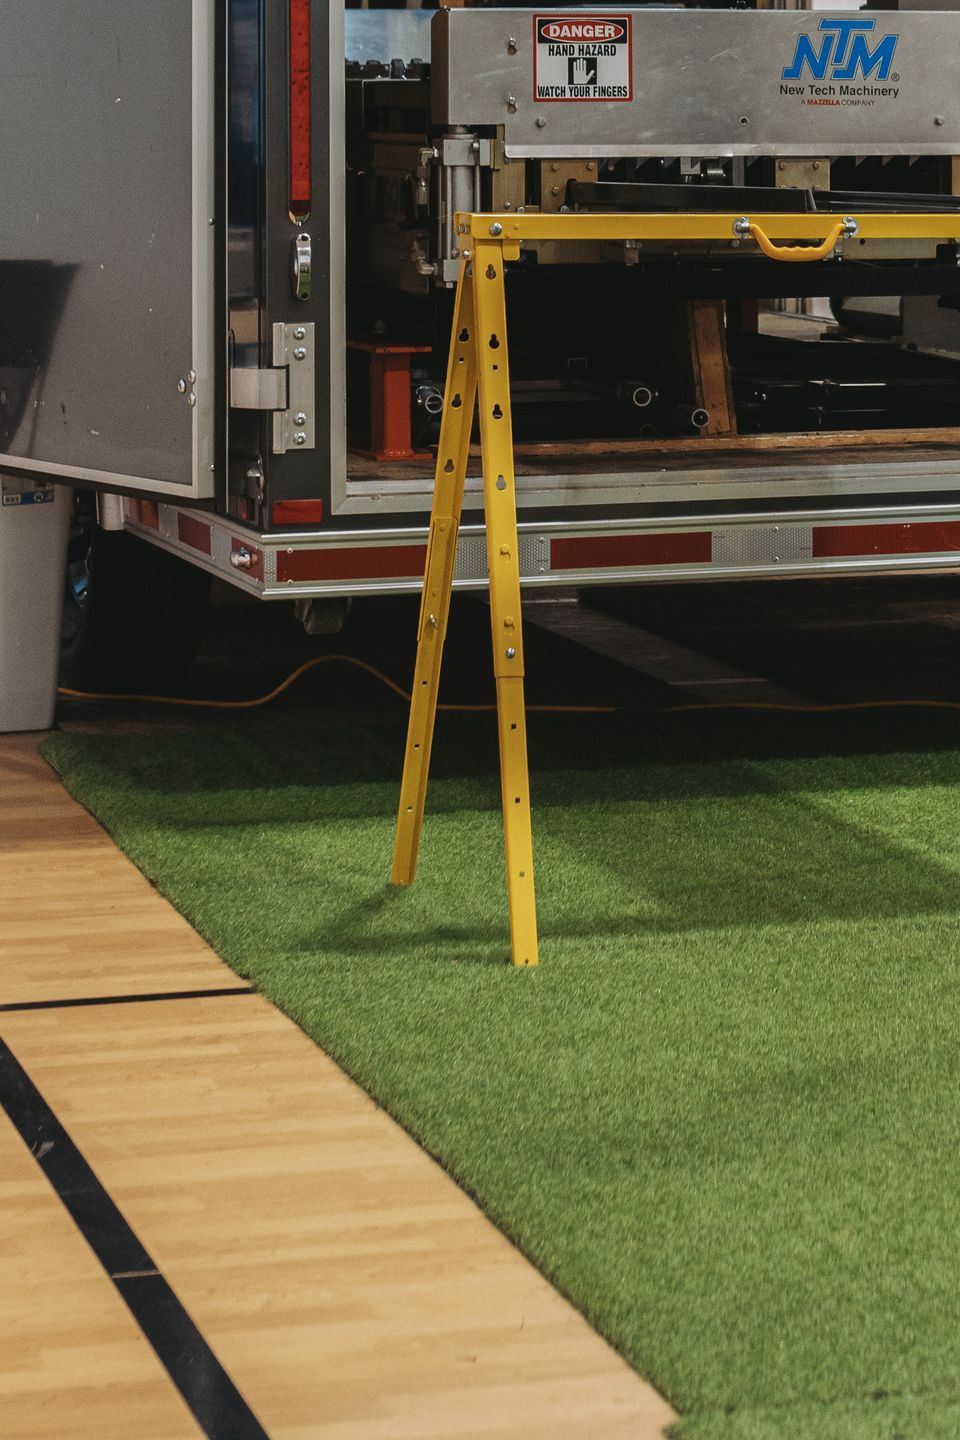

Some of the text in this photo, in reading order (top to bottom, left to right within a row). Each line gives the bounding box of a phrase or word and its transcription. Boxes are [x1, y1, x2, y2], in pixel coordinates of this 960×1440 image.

[549, 25, 615, 37] DANGER
[548, 45, 617, 56] HAND HAZARD
[538, 86, 628, 97] WATCH YOUR FINGERS
[780, 85, 899, 98] New Tech Machinery
